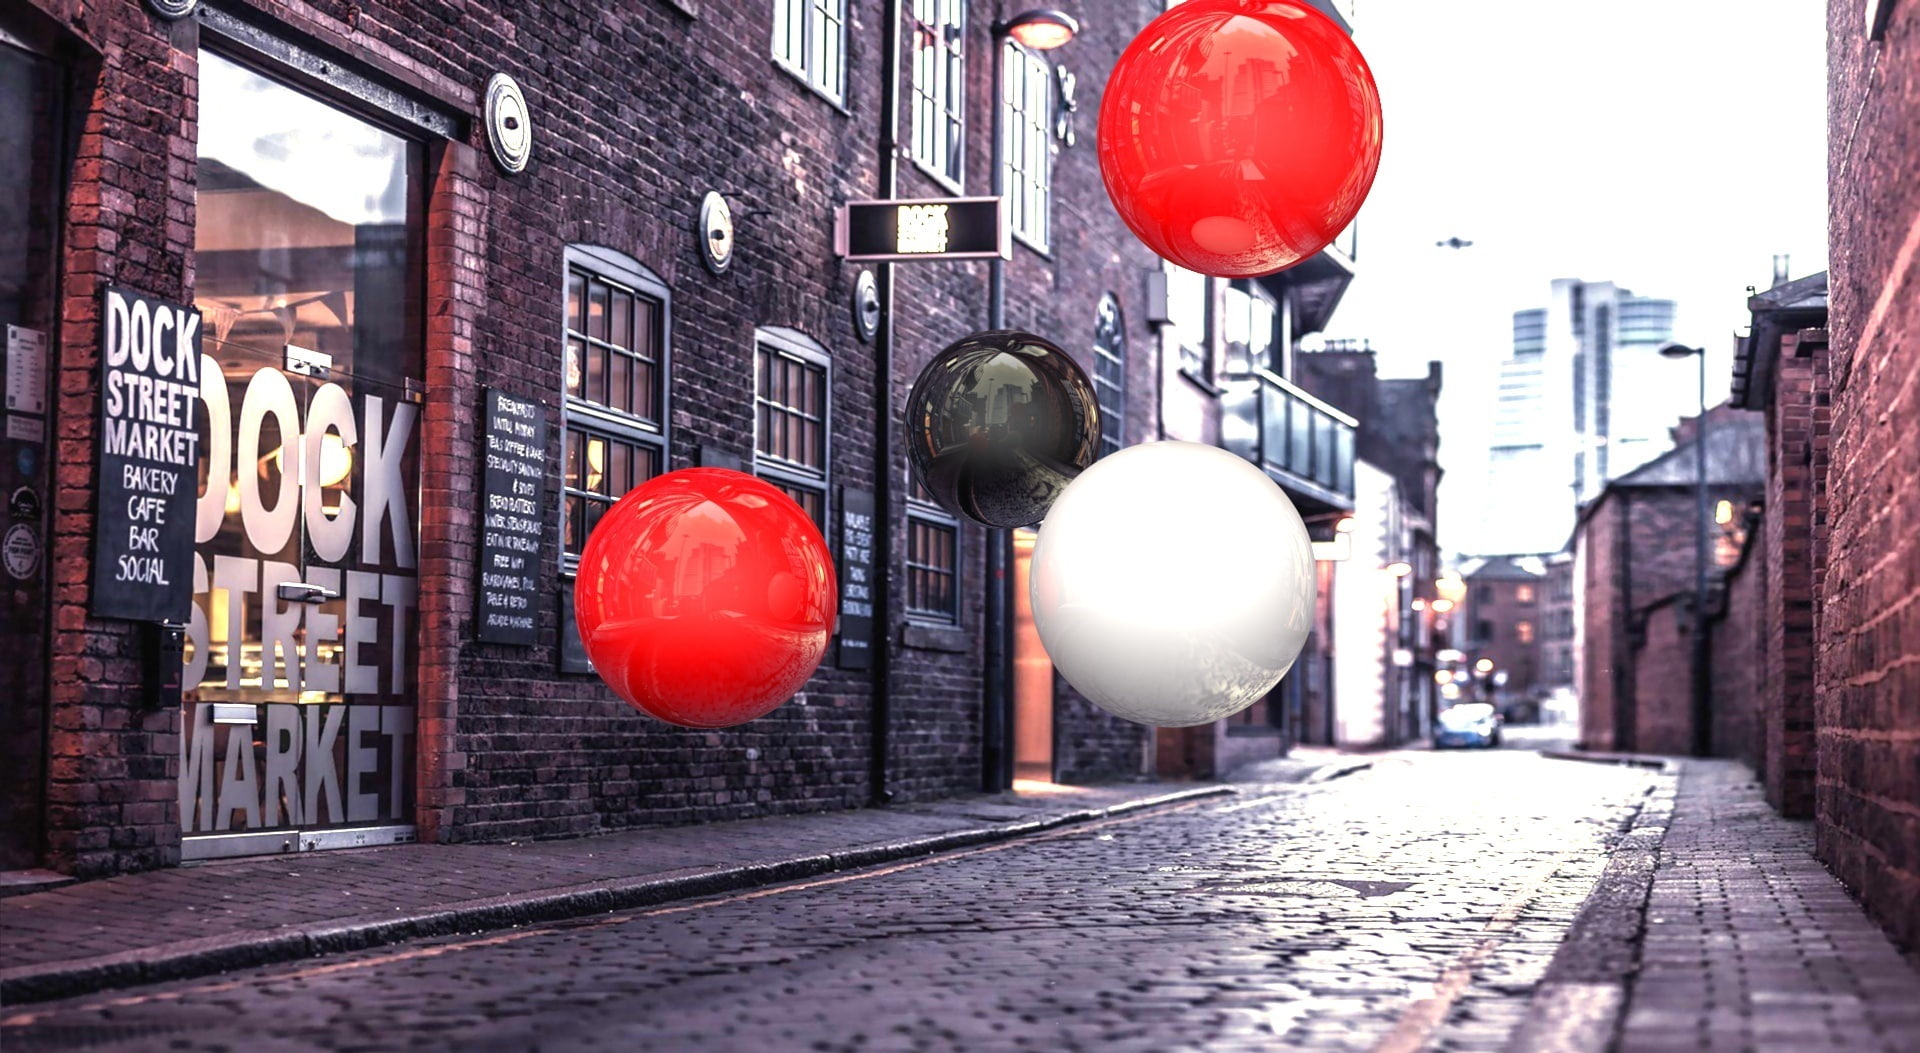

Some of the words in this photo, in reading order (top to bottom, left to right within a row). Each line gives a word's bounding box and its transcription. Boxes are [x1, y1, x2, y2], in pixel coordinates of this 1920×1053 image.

[107, 291, 200, 383] DOCK
[107, 369, 199, 430] STREET
[105, 417, 199, 467] MARKET
[195, 354, 419, 569] DOCK
[123, 464, 178, 496] BAKERY
[128, 495, 167, 525] CAFE
[129, 525, 159, 553] BAR
[116, 554, 170, 586] SOCIAL
[178, 702, 414, 833] MARKET
